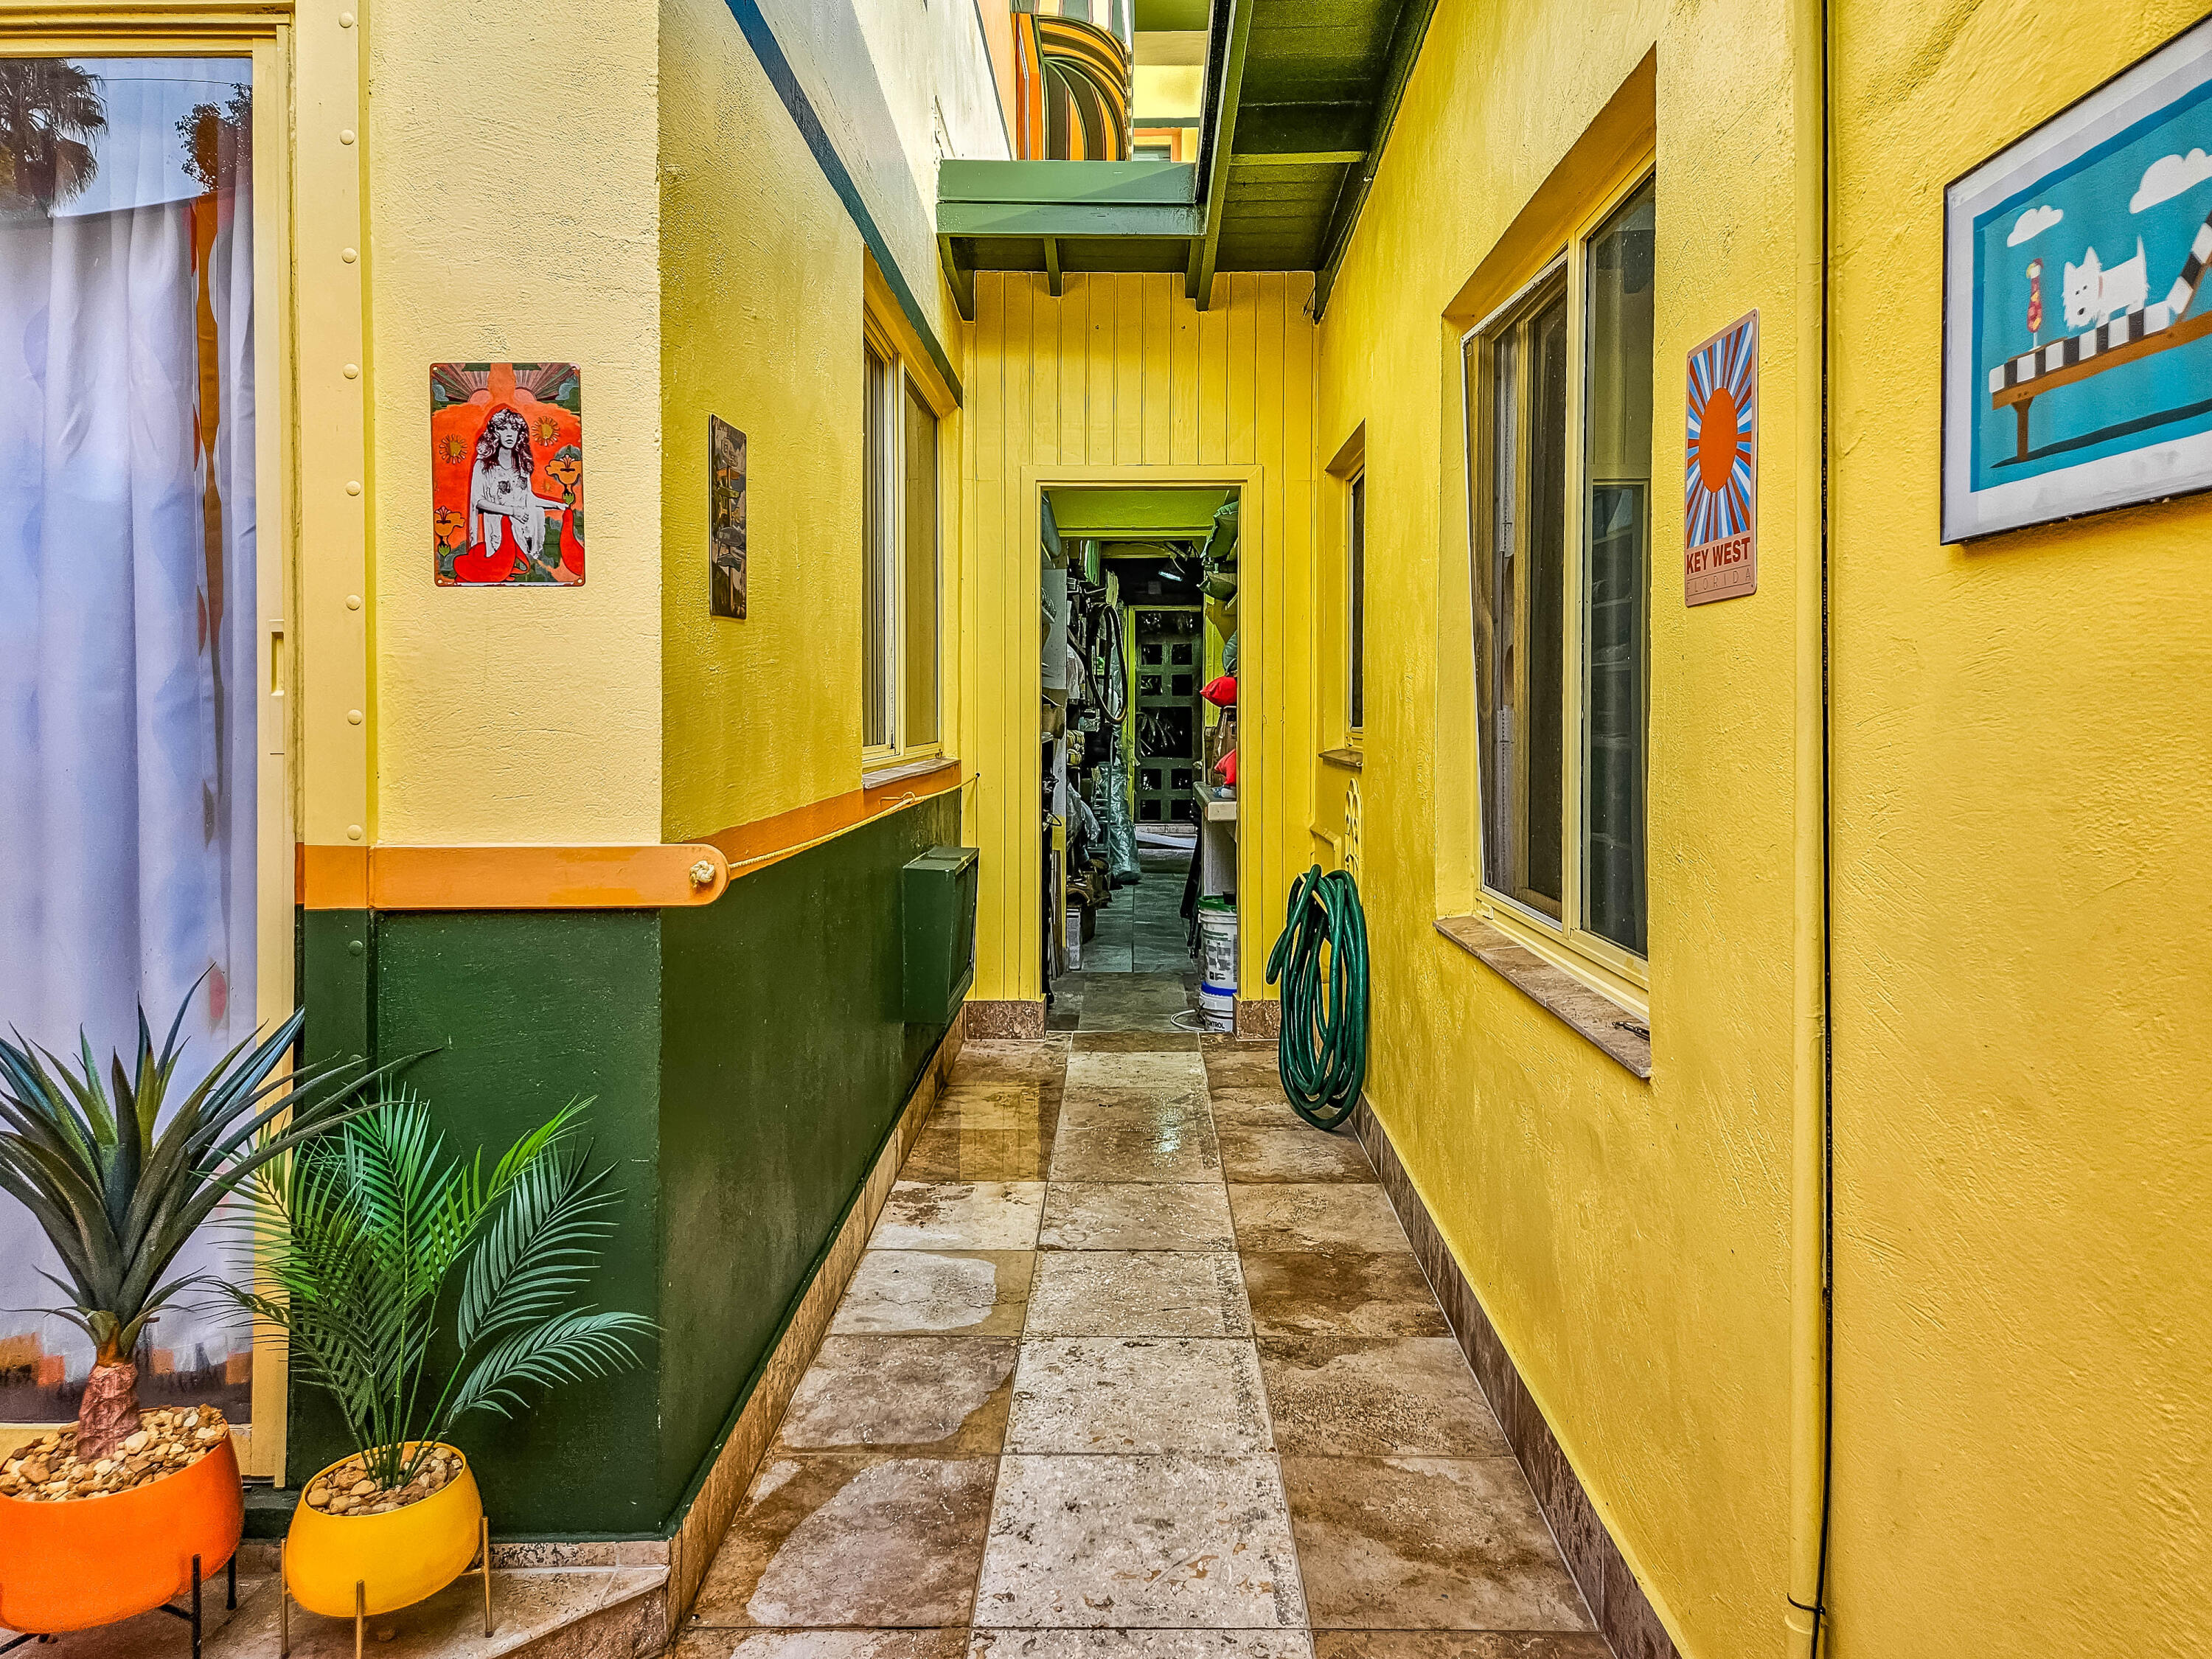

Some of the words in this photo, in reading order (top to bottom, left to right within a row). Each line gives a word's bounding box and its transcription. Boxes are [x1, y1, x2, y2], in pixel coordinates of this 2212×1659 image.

[1686, 548, 1709, 574] KEY
[1712, 537, 1750, 568] WEST
[1686, 567, 1751, 595] FLORIDA
